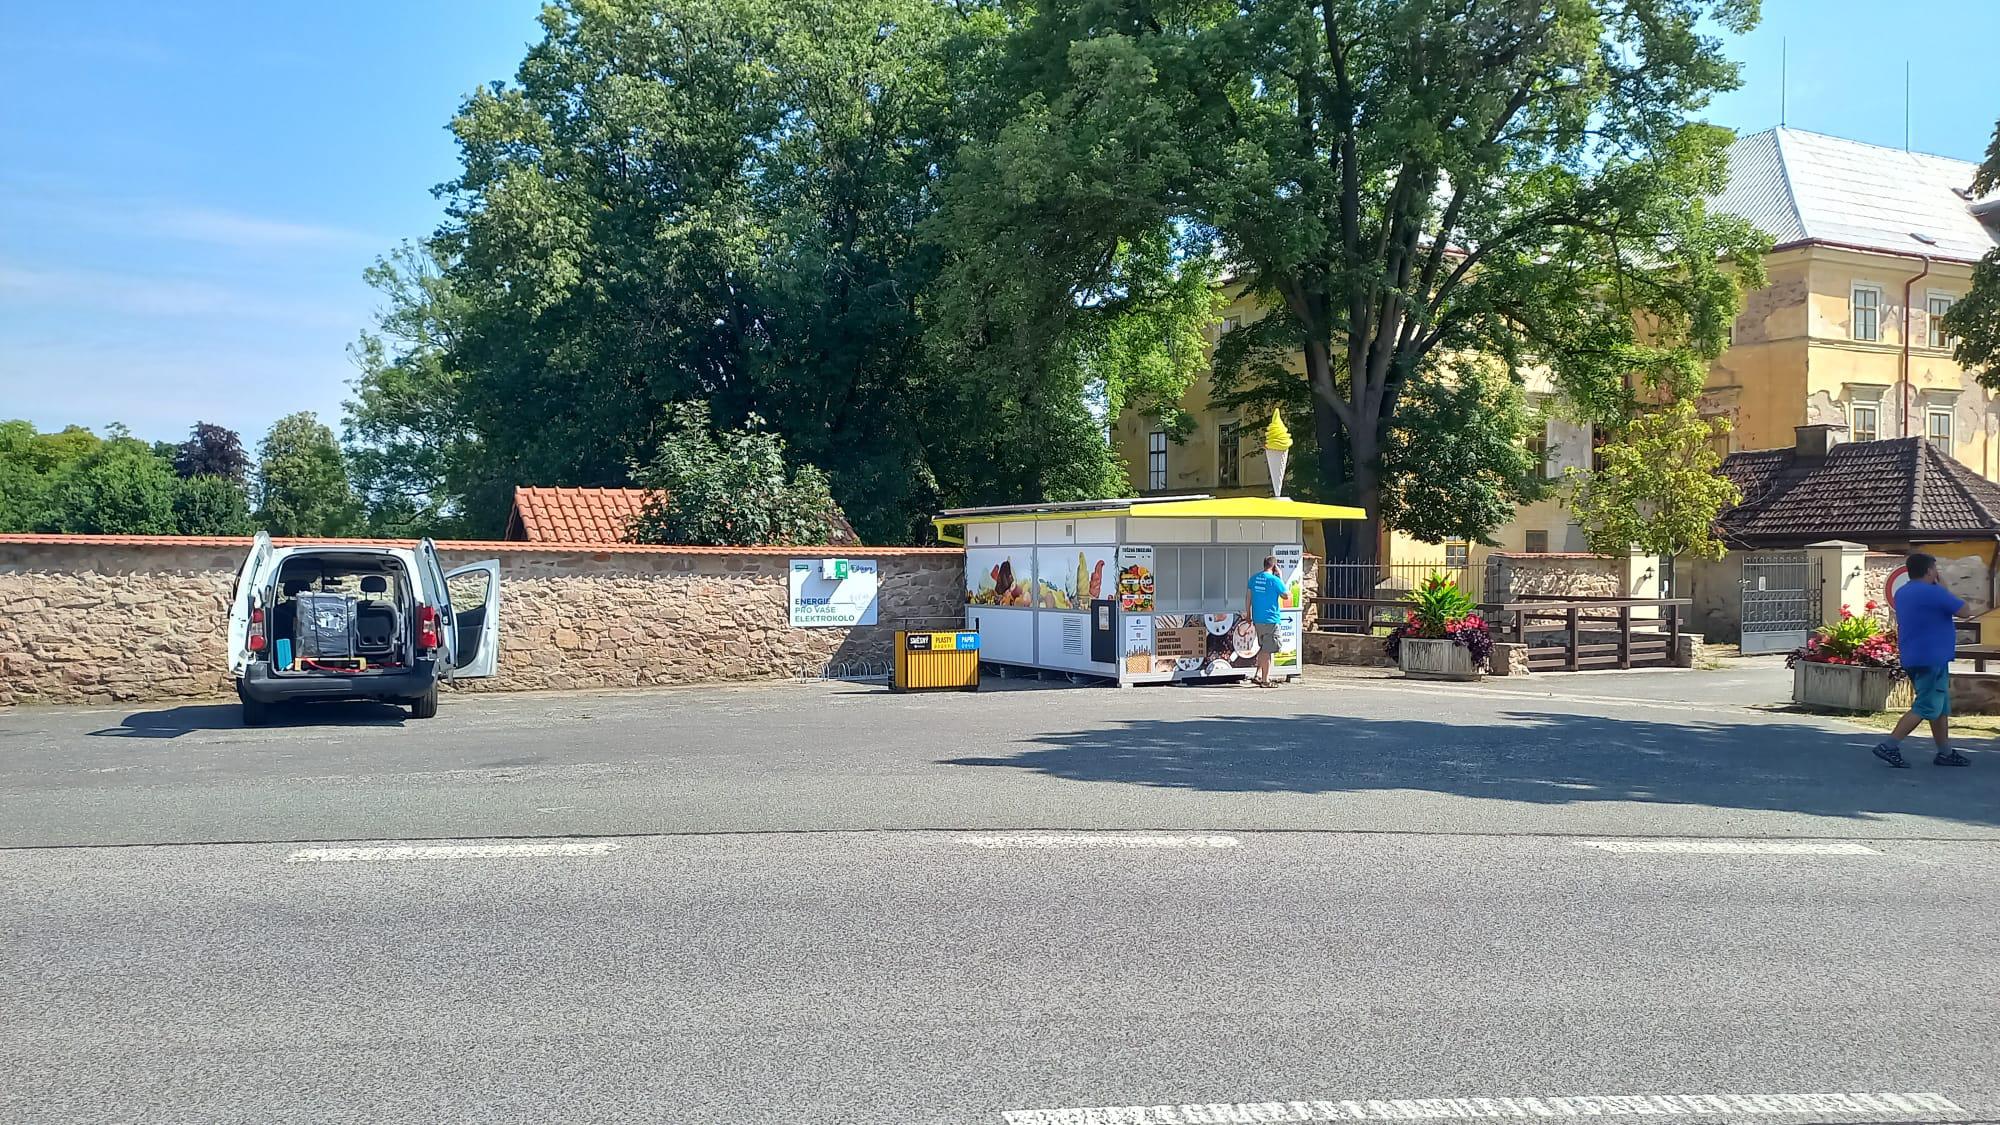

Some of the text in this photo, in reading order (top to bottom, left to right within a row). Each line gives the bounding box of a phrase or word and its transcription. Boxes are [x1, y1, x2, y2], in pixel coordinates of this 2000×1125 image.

[795, 597, 831, 606] ENERGIE
[795, 606, 813, 614] PRO
[795, 614, 855, 623] ELEKTROKOLO
[935, 636, 952, 644] PLASTY
